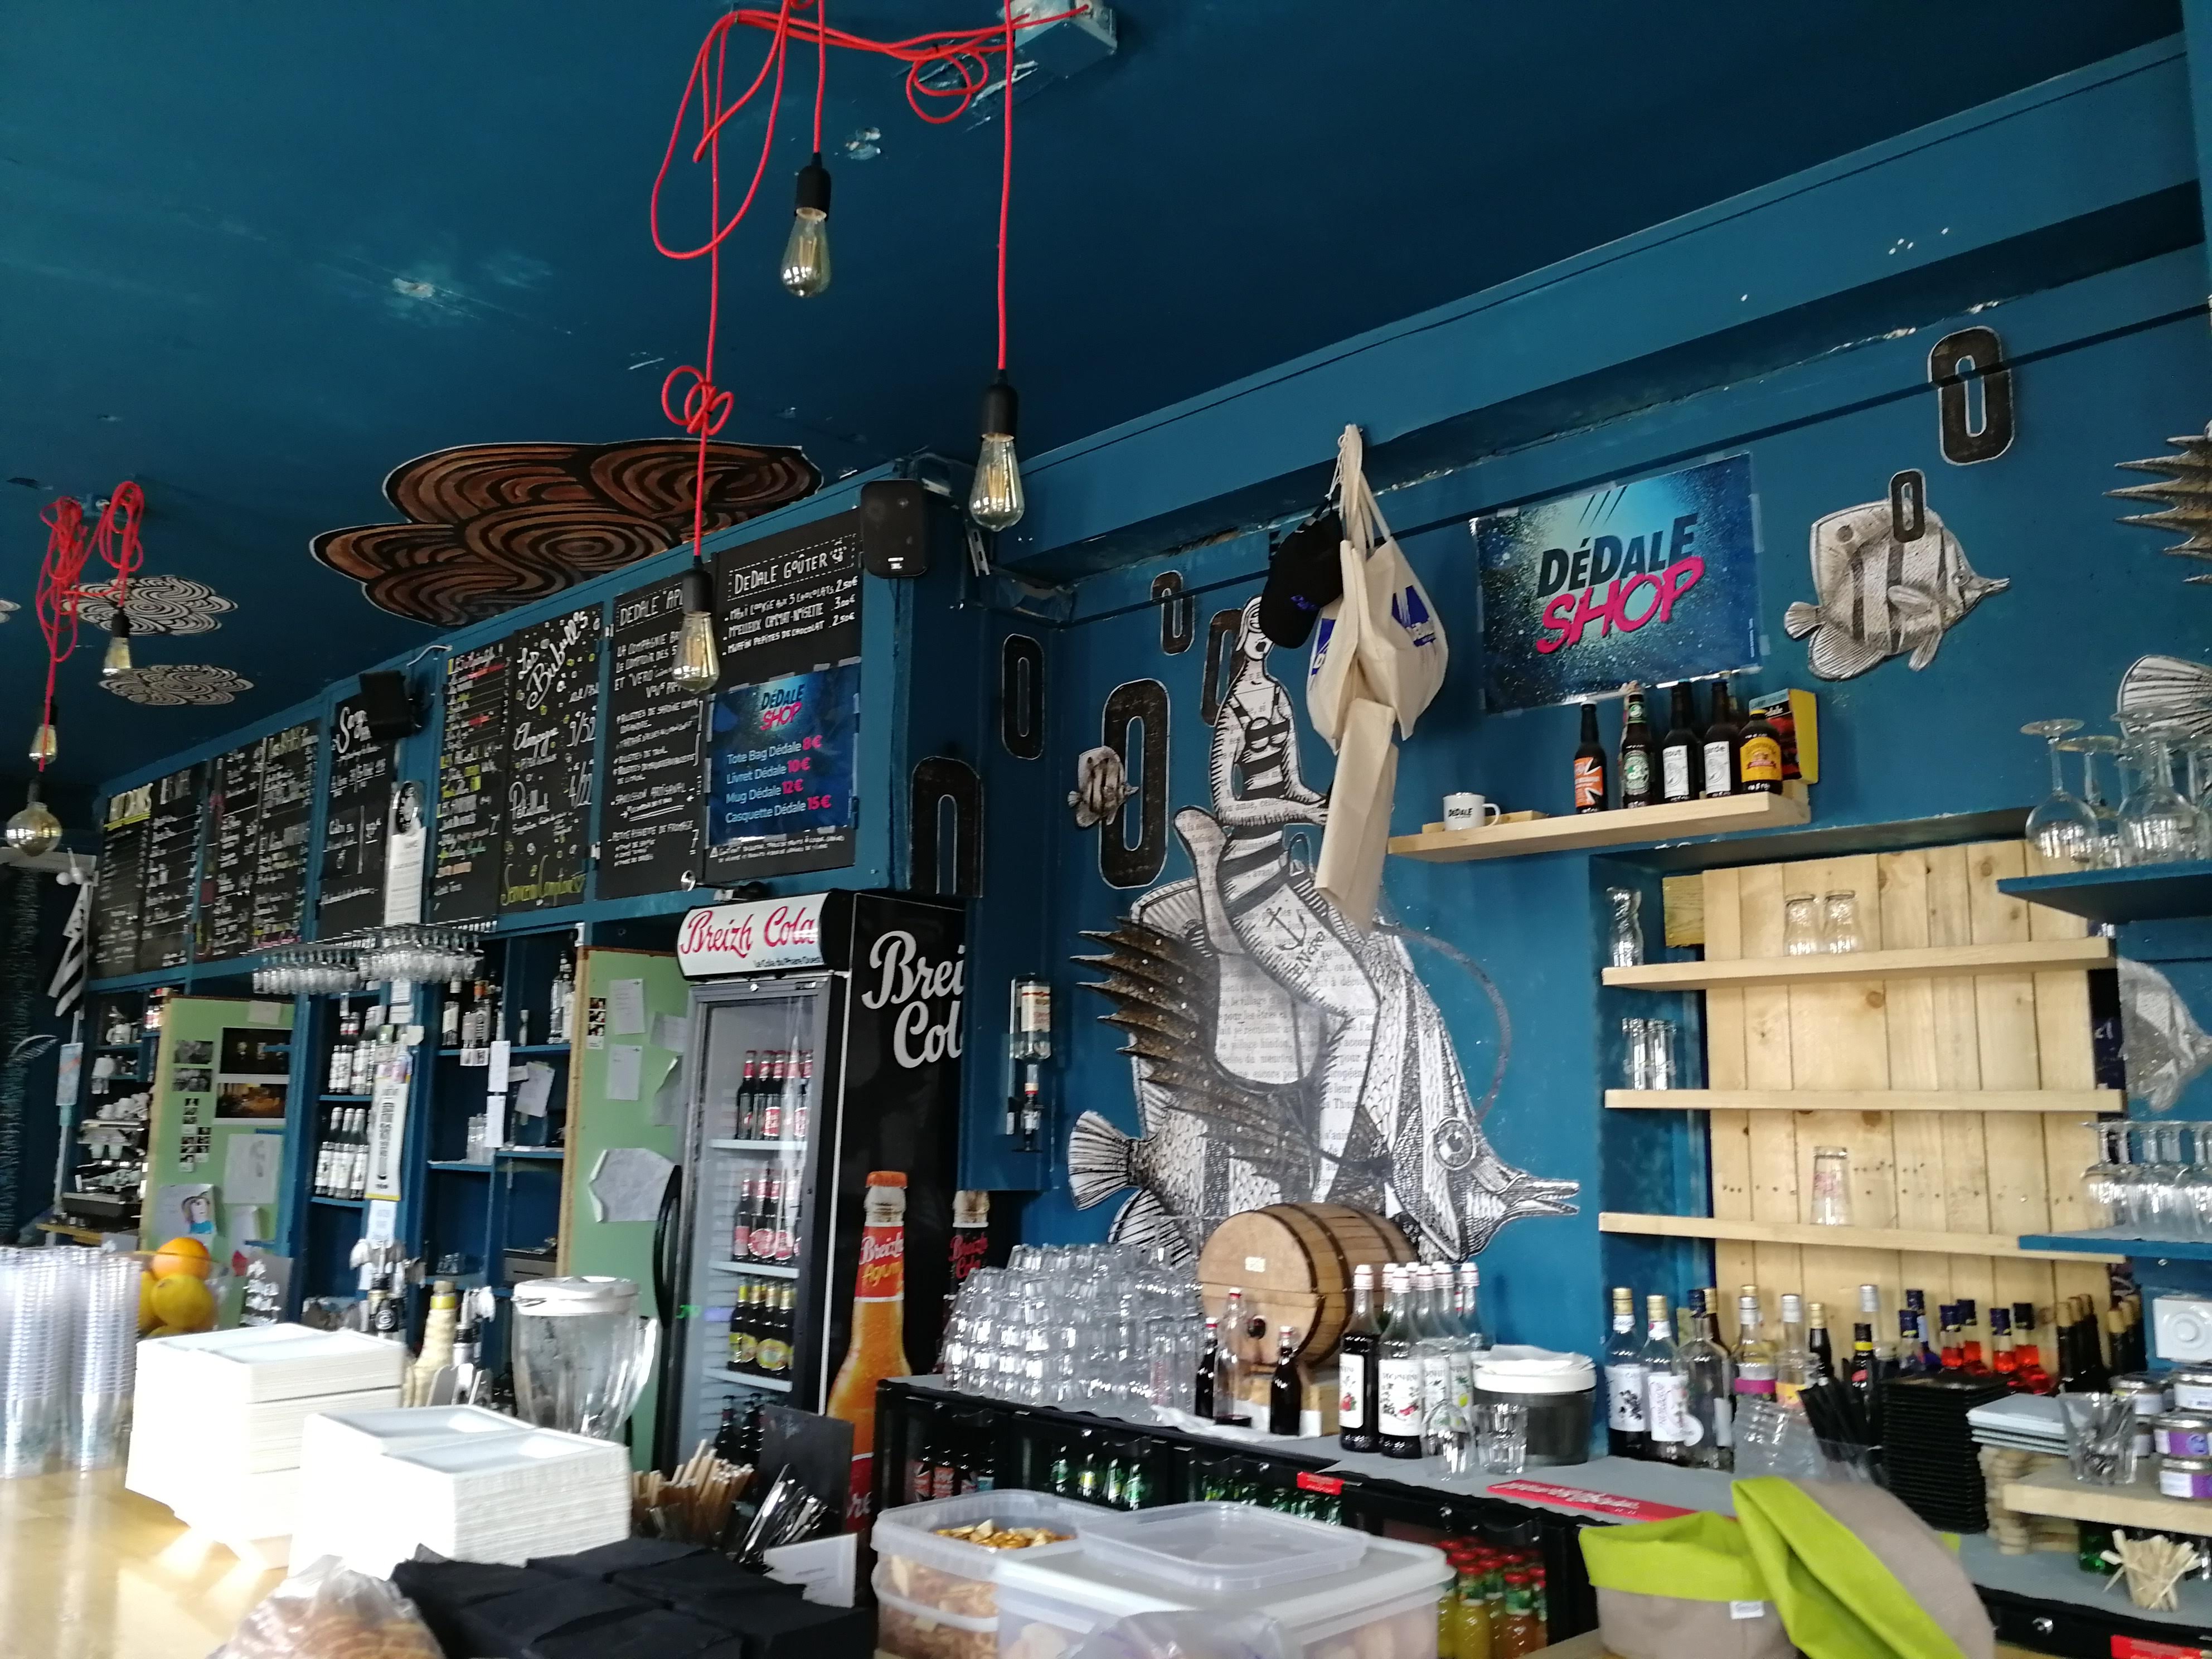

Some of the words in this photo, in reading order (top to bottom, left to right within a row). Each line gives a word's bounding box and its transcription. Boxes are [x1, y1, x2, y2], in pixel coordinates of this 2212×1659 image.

[789, 593, 795, 605] 3
[1536, 556, 1705, 654] SHOP
[760, 701, 802, 731] SHOP
[726, 754, 748, 765] Tote
[749, 749, 768, 762] Bag
[769, 741, 802, 758] Dédale
[726, 771, 753, 784] Livret
[754, 764, 787, 780] Dédale
[787, 757, 811, 773] 10€
[726, 792, 747, 804] Mug
[748, 784, 782, 801] Dédale
[782, 778, 804, 794] 12€
[725, 807, 773, 824] Casquette
[774, 801, 806, 817] Dédale
[807, 794, 832, 811] 15€
[680, 909, 754, 958] Breizh
[763, 905, 818, 948] Cola
[861, 930, 966, 1010] Brei
[893, 1000, 965, 1068] Col
